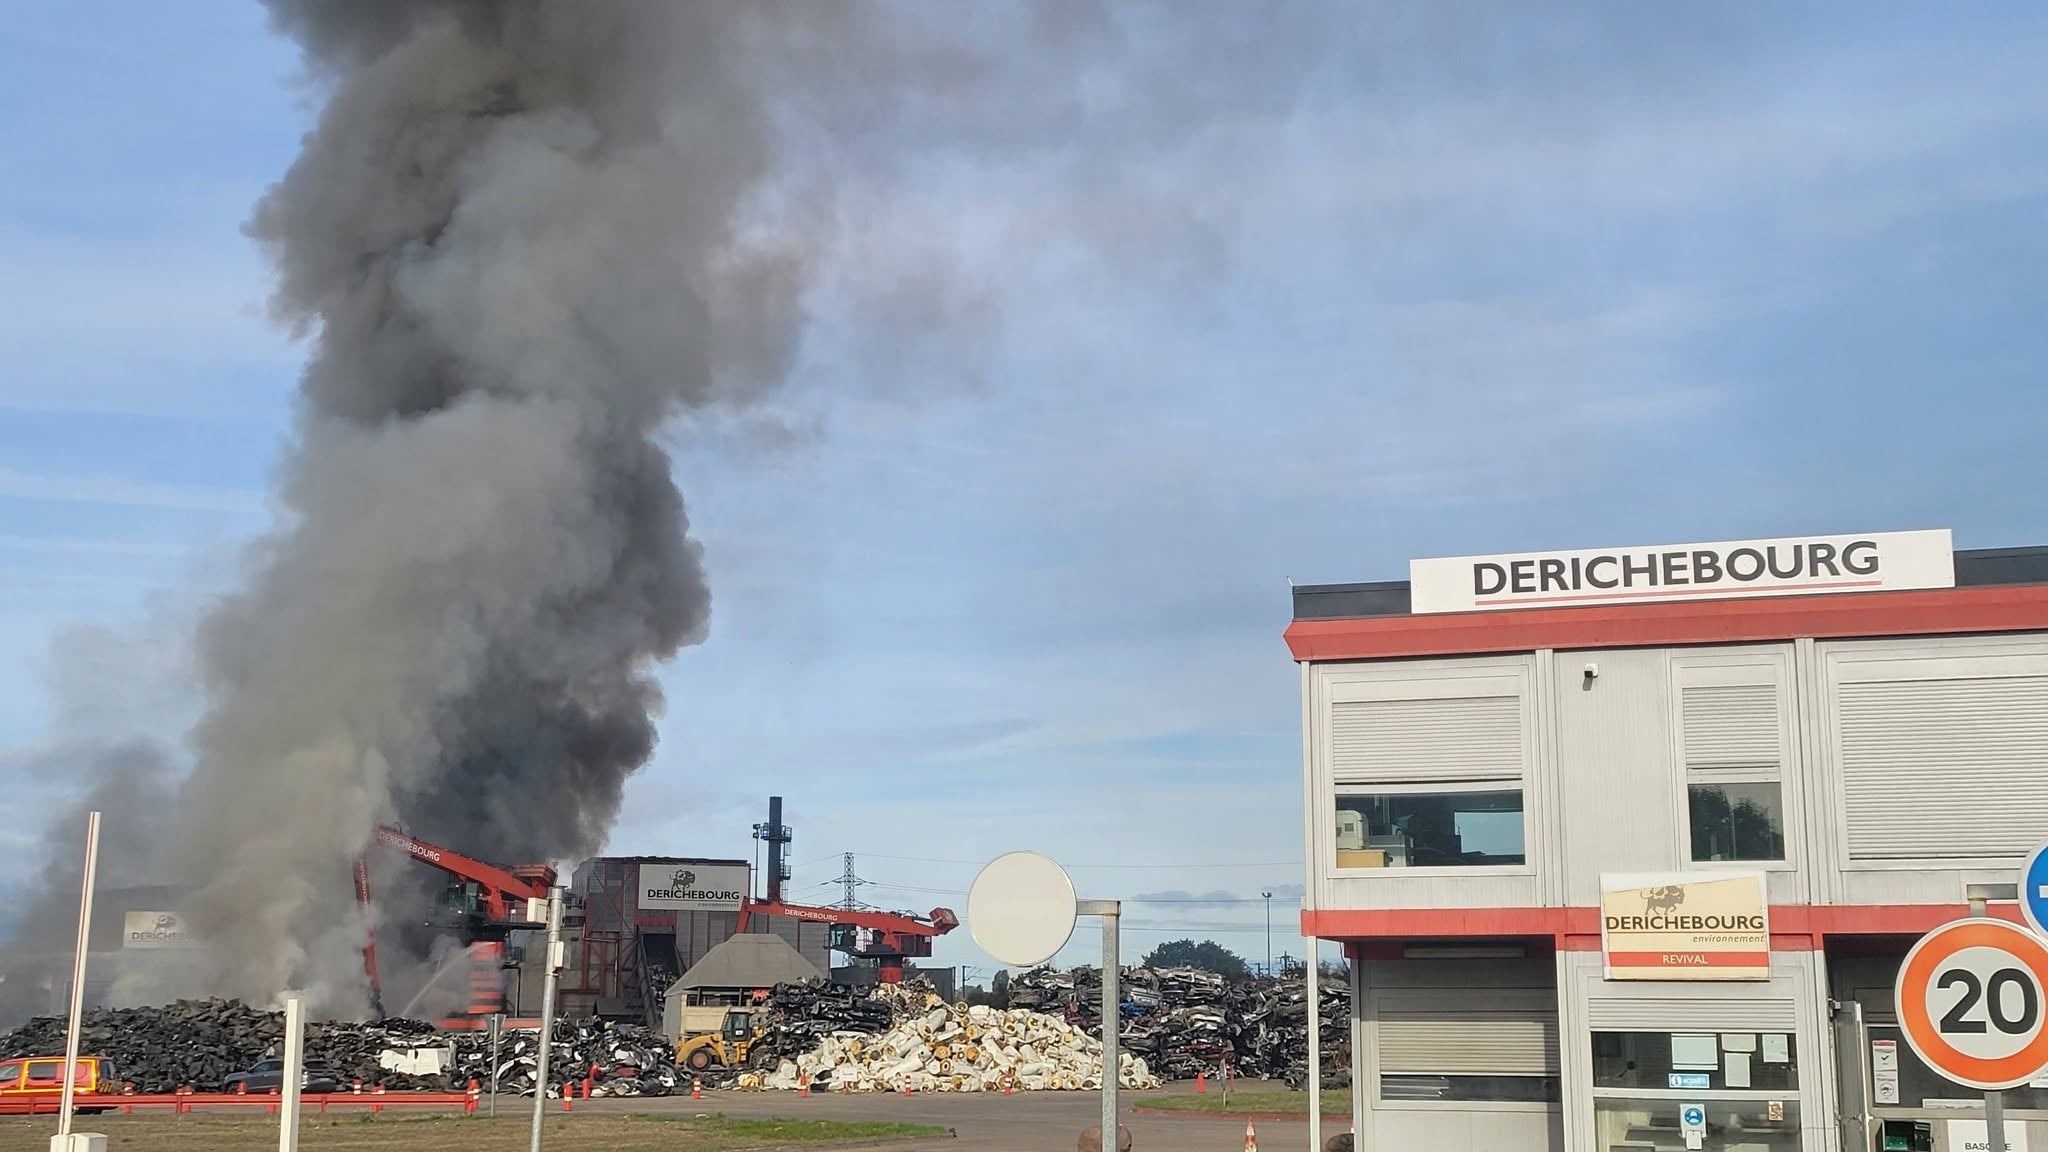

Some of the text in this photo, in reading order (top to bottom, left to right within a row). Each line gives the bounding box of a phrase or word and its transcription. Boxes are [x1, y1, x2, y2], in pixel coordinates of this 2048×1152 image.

[1473, 541, 1879, 595] DERICHEBOURG
[378, 831, 440, 862] DERICHEBOURG
[647, 889, 740, 900] DERICHEBOURG
[784, 908, 838, 921] DERICHEBOURG
[1606, 915, 1764, 930] DERICHEBOURG
[1692, 934, 1766, 943] environnement
[1662, 954, 1709, 965] REVIVAL
[1937, 967, 2039, 1035] 20
[1964, 1142, 2012, 1151] BASCE
